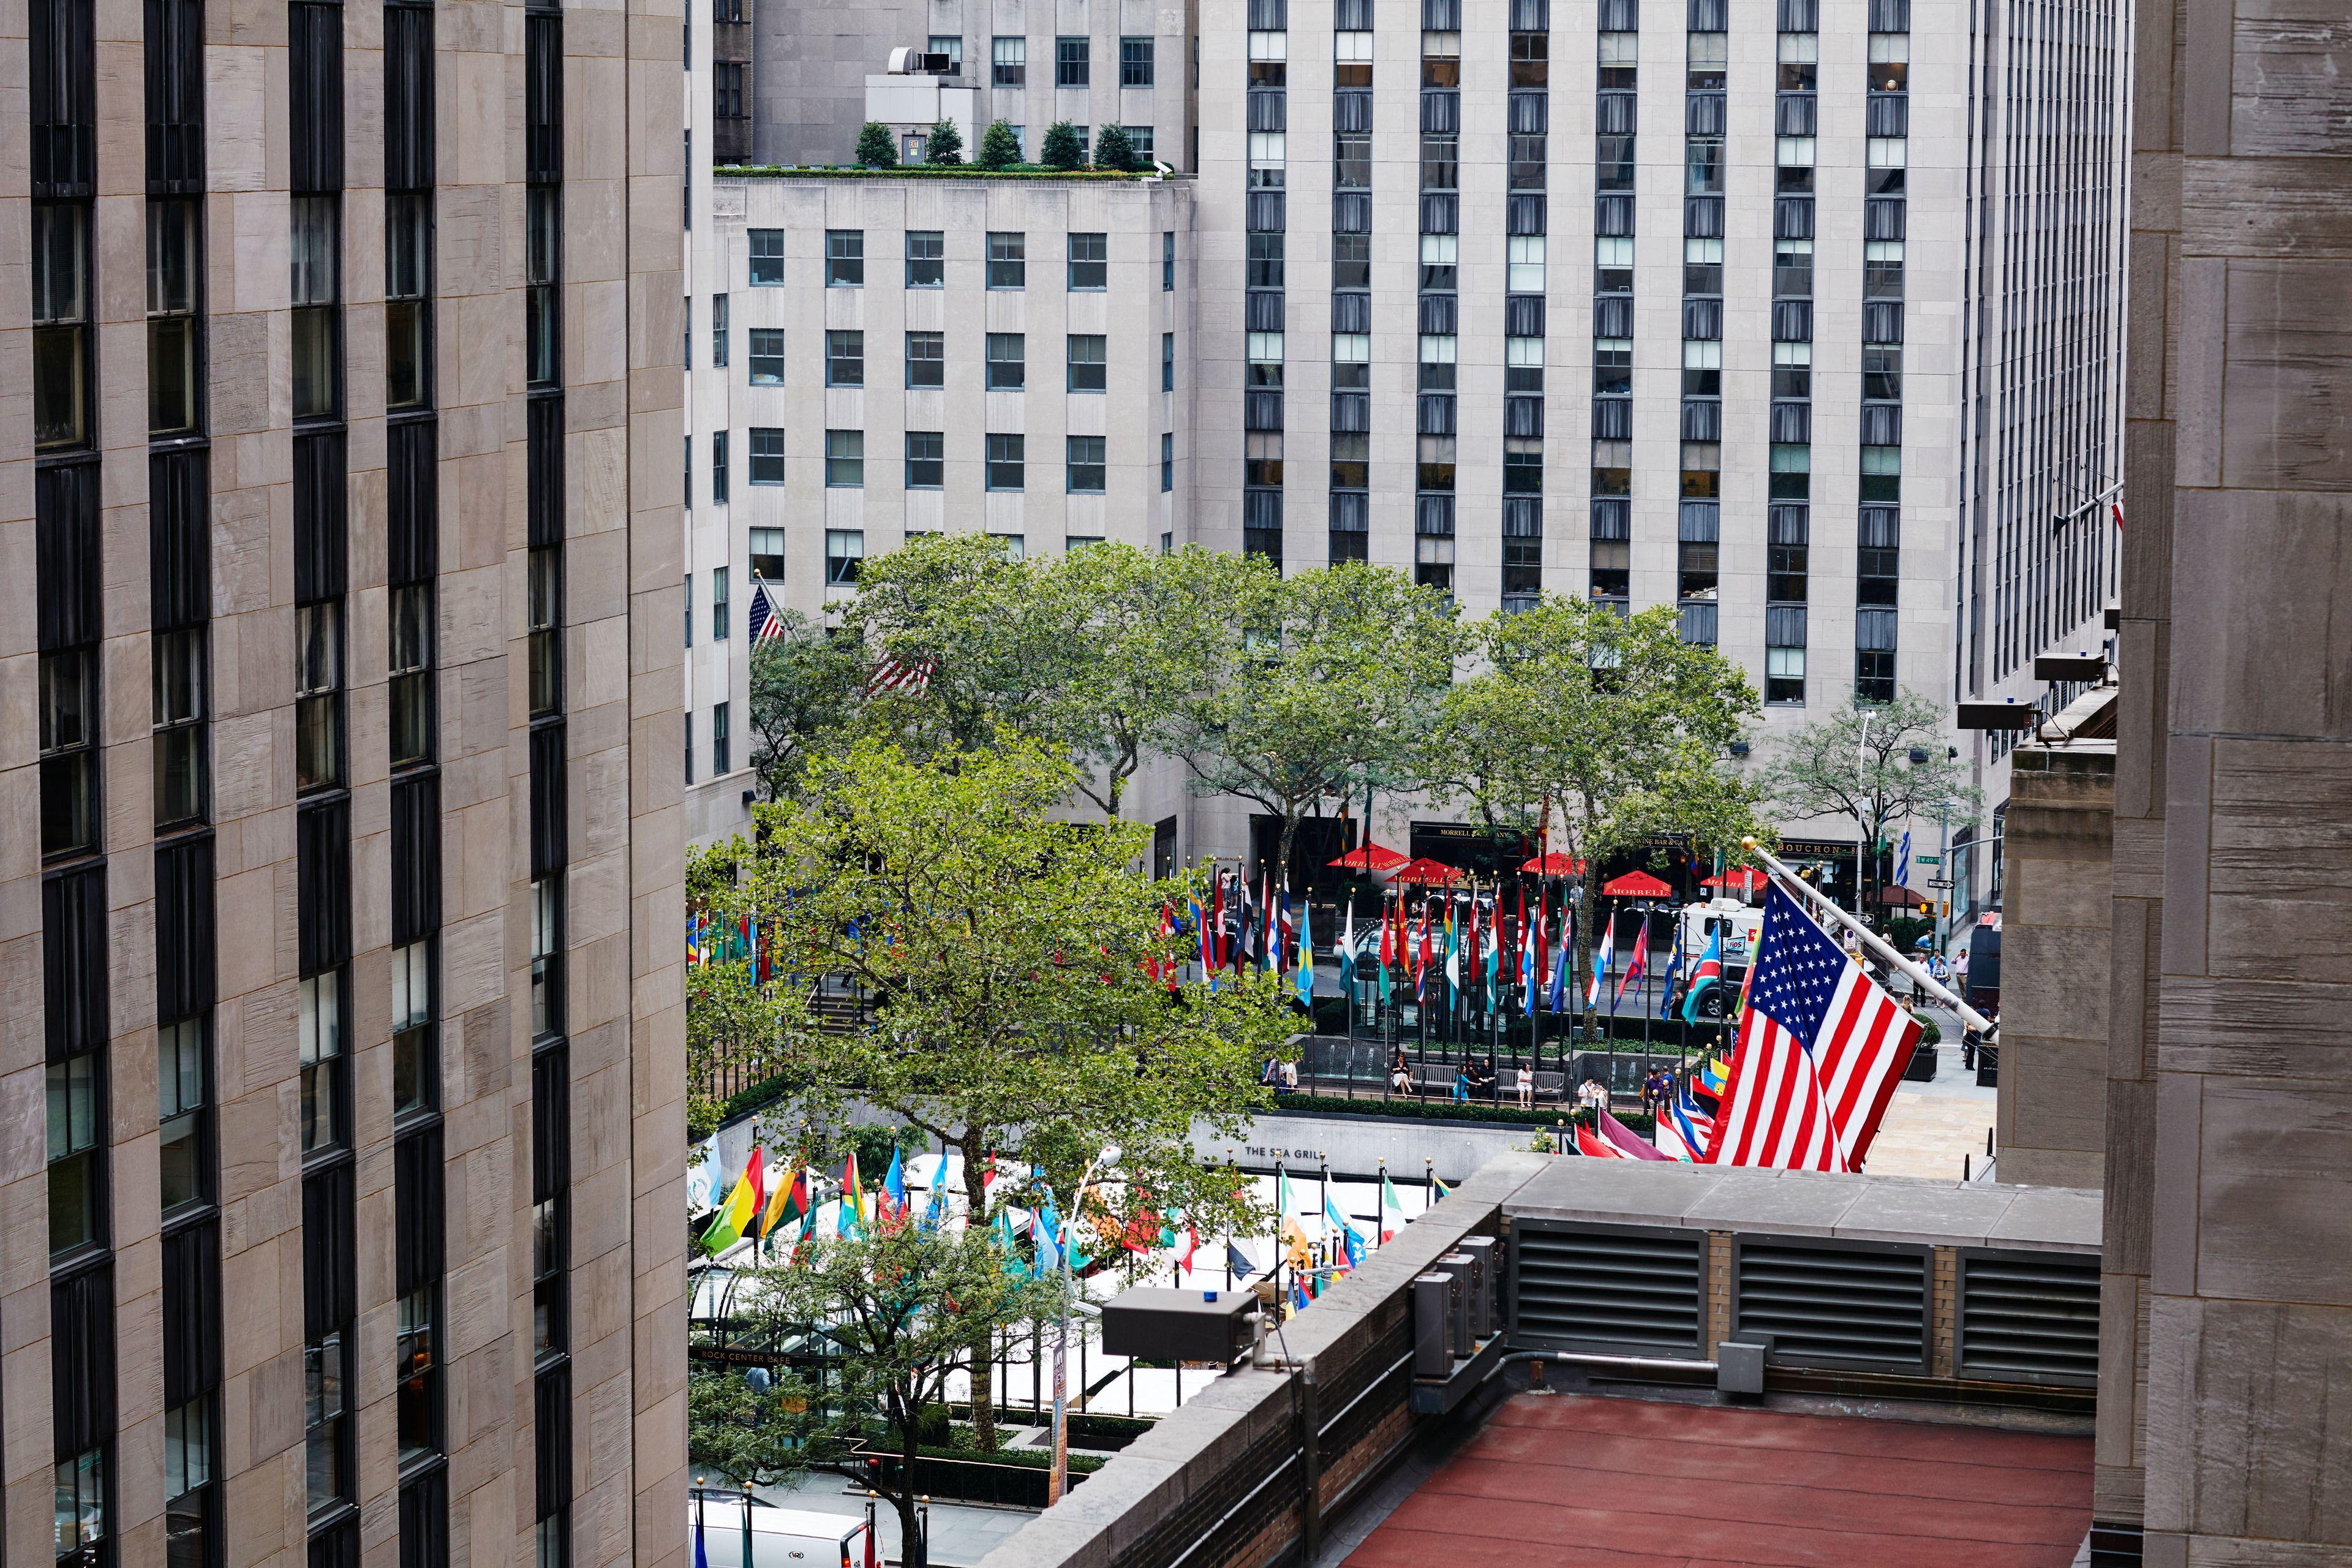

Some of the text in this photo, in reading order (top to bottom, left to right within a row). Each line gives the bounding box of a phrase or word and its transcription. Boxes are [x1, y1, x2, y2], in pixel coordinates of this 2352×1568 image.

[1777, 843, 1839, 854] BOUCHON
[1527, 865, 1573, 875] MORREL
[1245, 1147, 1265, 1156] THE
[1294, 1150, 1323, 1159] GRIL
[729, 1353, 764, 1362] CENTER
